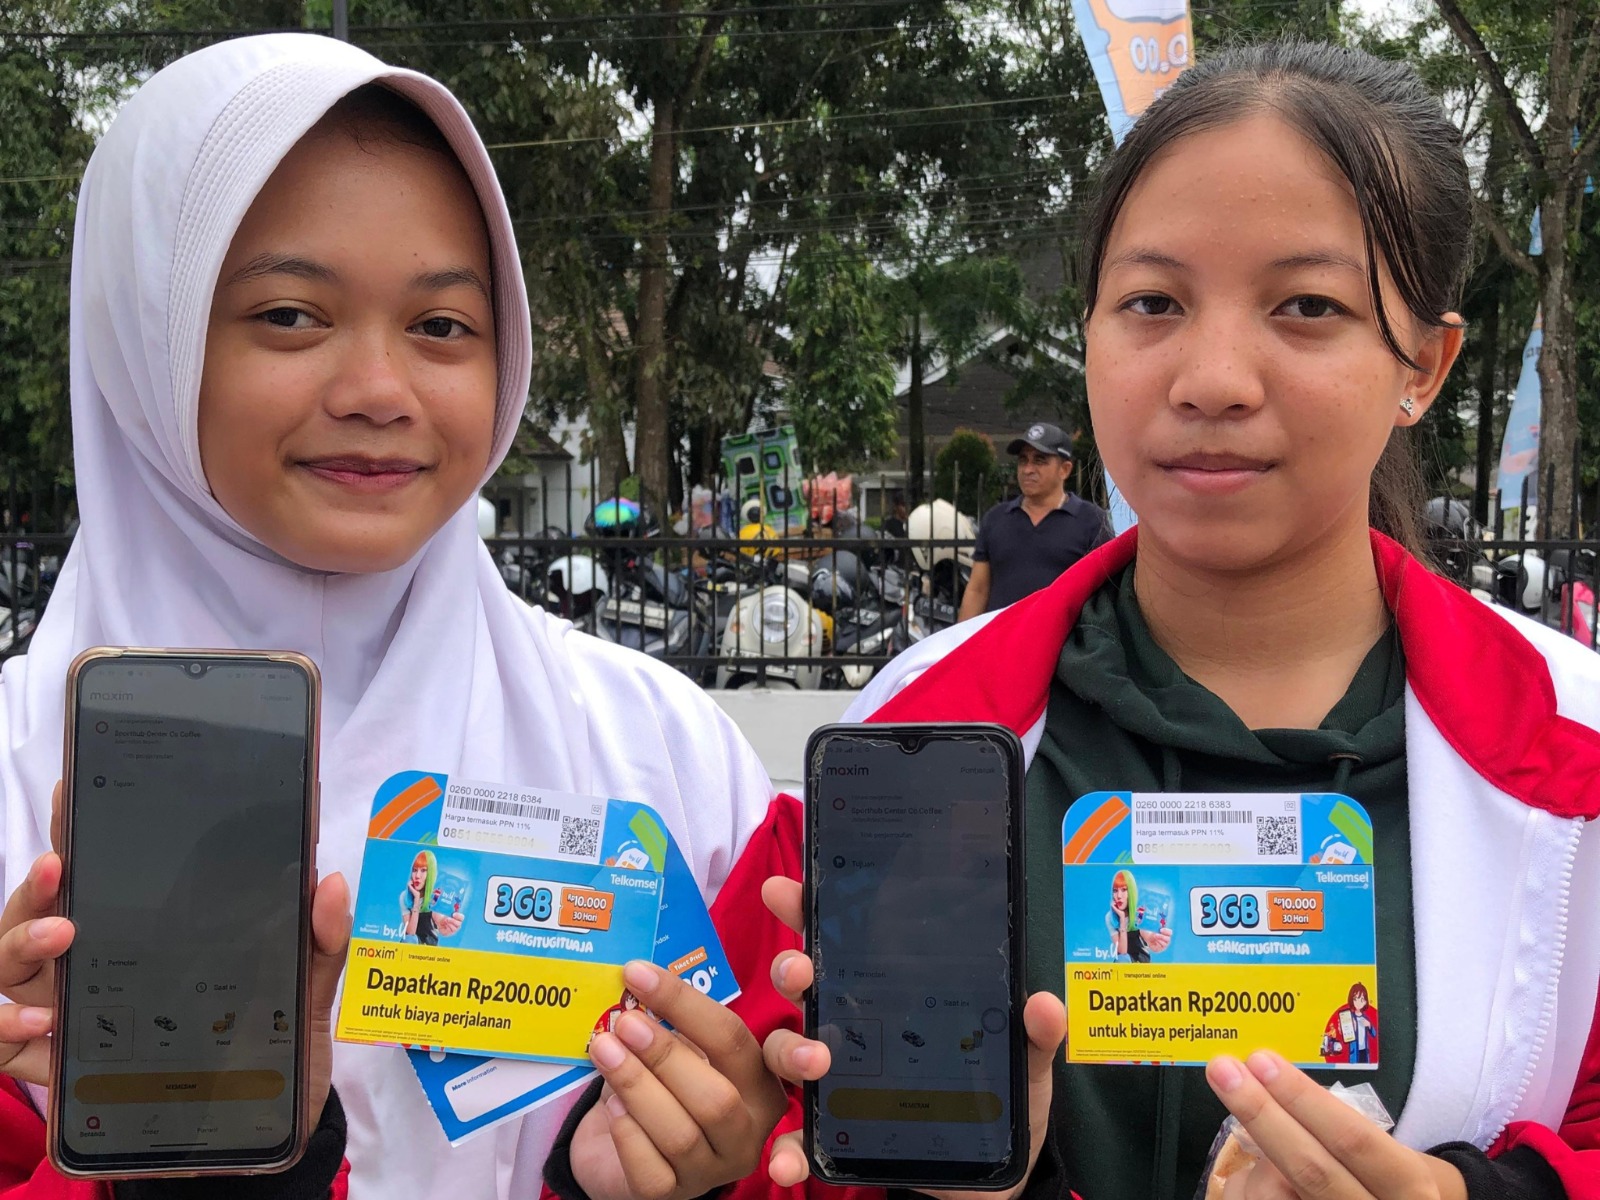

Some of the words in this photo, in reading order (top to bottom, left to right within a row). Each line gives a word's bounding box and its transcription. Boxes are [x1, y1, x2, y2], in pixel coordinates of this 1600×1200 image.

[90, 691, 133, 701] maxim
[826, 764, 869, 776] maxim
[449, 784, 471, 795] 0260
[474, 788, 496, 798] 0000
[497, 791, 519, 802] 2218
[520, 794, 542, 804] 6384
[1136, 800, 1158, 809] 0260
[1160, 800, 1182, 809] 0000
[1184, 800, 1206, 809] 2218
[1208, 800, 1232, 809] 6383
[444, 813, 466, 823] Harga
[466, 816, 498, 826] termasuk
[498, 819, 514, 828] PPN
[516, 822, 530, 830] 11%
[1136, 829, 1156, 838] Harga
[610, 874, 658, 890] Telkomsel
[1316, 872, 1369, 884] Telkomsel
[495, 883, 553, 921] 3GB
[568, 892, 607, 910] Rp10.000
[1274, 897, 1317, 910] Rp10.000
[572, 912, 584, 921] 30
[584, 912, 598, 922] Hari
[1200, 894, 1259, 928] 3GB
[1282, 914, 1294, 924] 30
[1294, 914, 1309, 924] Hari
[496, 930, 594, 953] #GAKGITUGITUAJA
[1206, 940, 1311, 956] #GAKGITUGITUAJA
[357, 946, 396, 960] maxim
[408, 954, 436, 962] transportasi
[690, 952, 704, 963] Price
[1095, 941, 1118, 960] by.U
[1074, 968, 1112, 980] maxim
[366, 967, 462, 998] Dapatkan
[1089, 990, 1182, 1016] Dapatkan
[362, 1003, 402, 1020] untuk
[404, 1004, 439, 1024] biaya
[442, 1010, 511, 1030] perjalanan
[1088, 1023, 1127, 1038] untuk
[1130, 1023, 1166, 1041] biaya
[1169, 1024, 1238, 1041] perjalanan
[269, 1038, 292, 1046] Delivery
[964, 1058, 980, 1066] Food
[452, 1080, 467, 1092] More
[467, 1066, 498, 1084] Information
